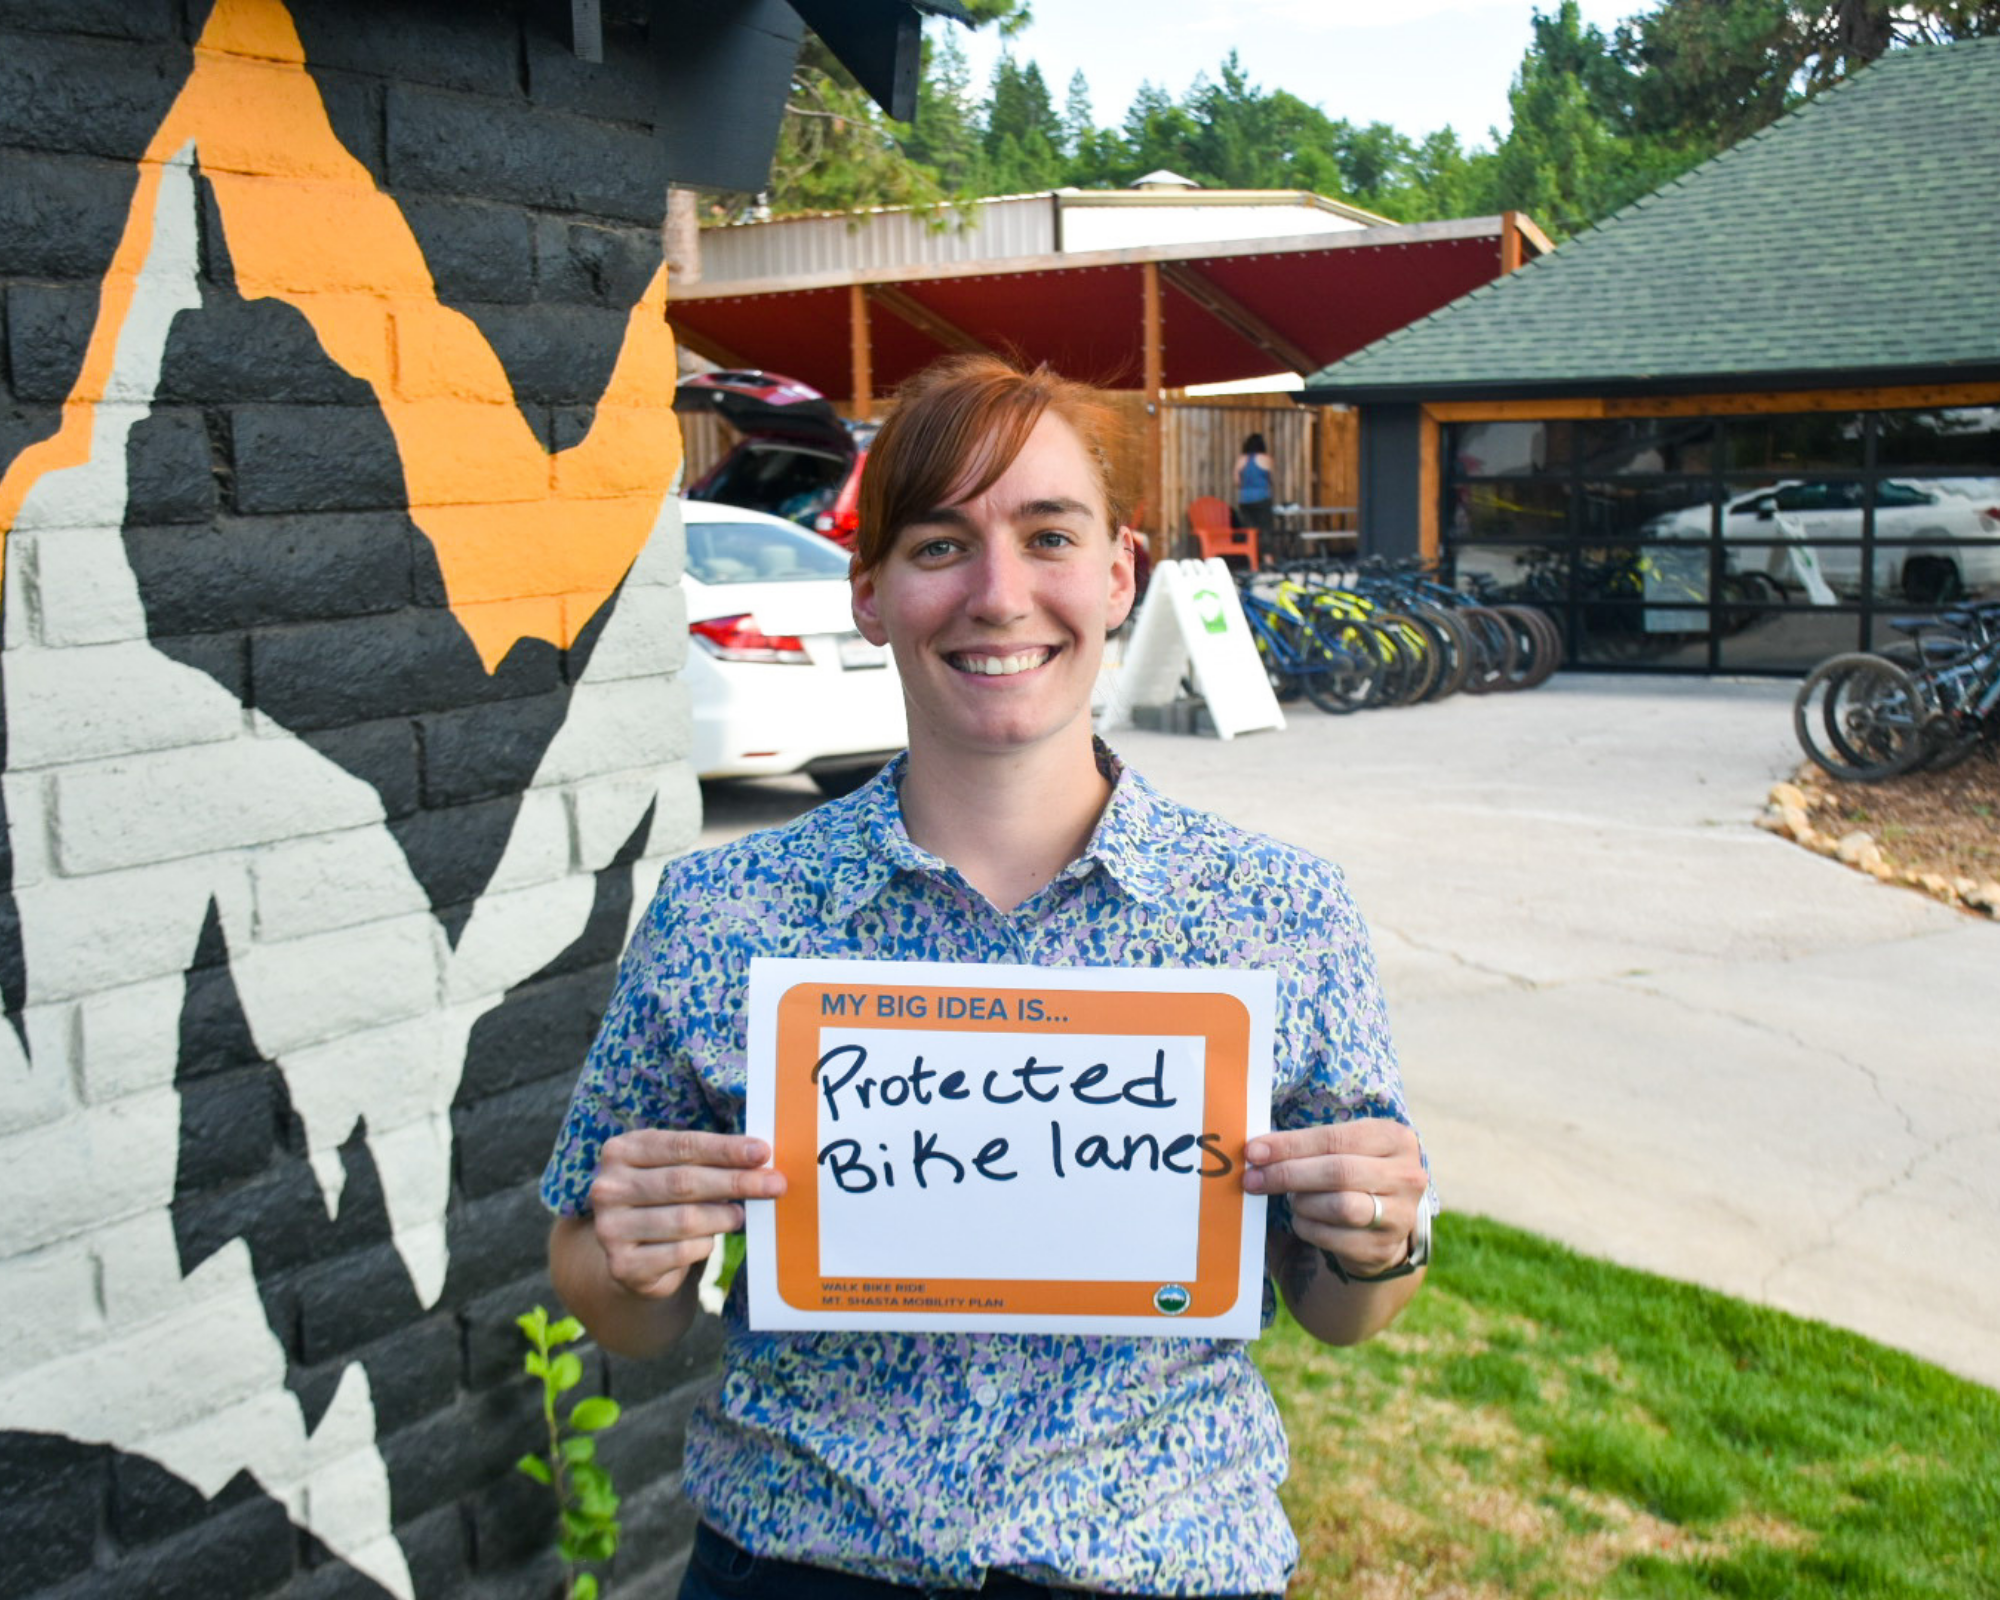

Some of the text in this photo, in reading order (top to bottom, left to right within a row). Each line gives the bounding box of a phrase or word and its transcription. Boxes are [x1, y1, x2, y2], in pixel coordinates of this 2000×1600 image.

[822, 993, 1069, 1022] MY BIG IDEA IS...
[812, 1044, 1177, 1121] Protected
[1051, 1121, 1234, 1177] lanes
[822, 1283, 926, 1294] WALK BIKE RIDE
[848, 1297, 899, 1306] SHASTA
[903, 1298, 965, 1308] MOBILITY
[969, 1299, 1004, 1308] PLAN
